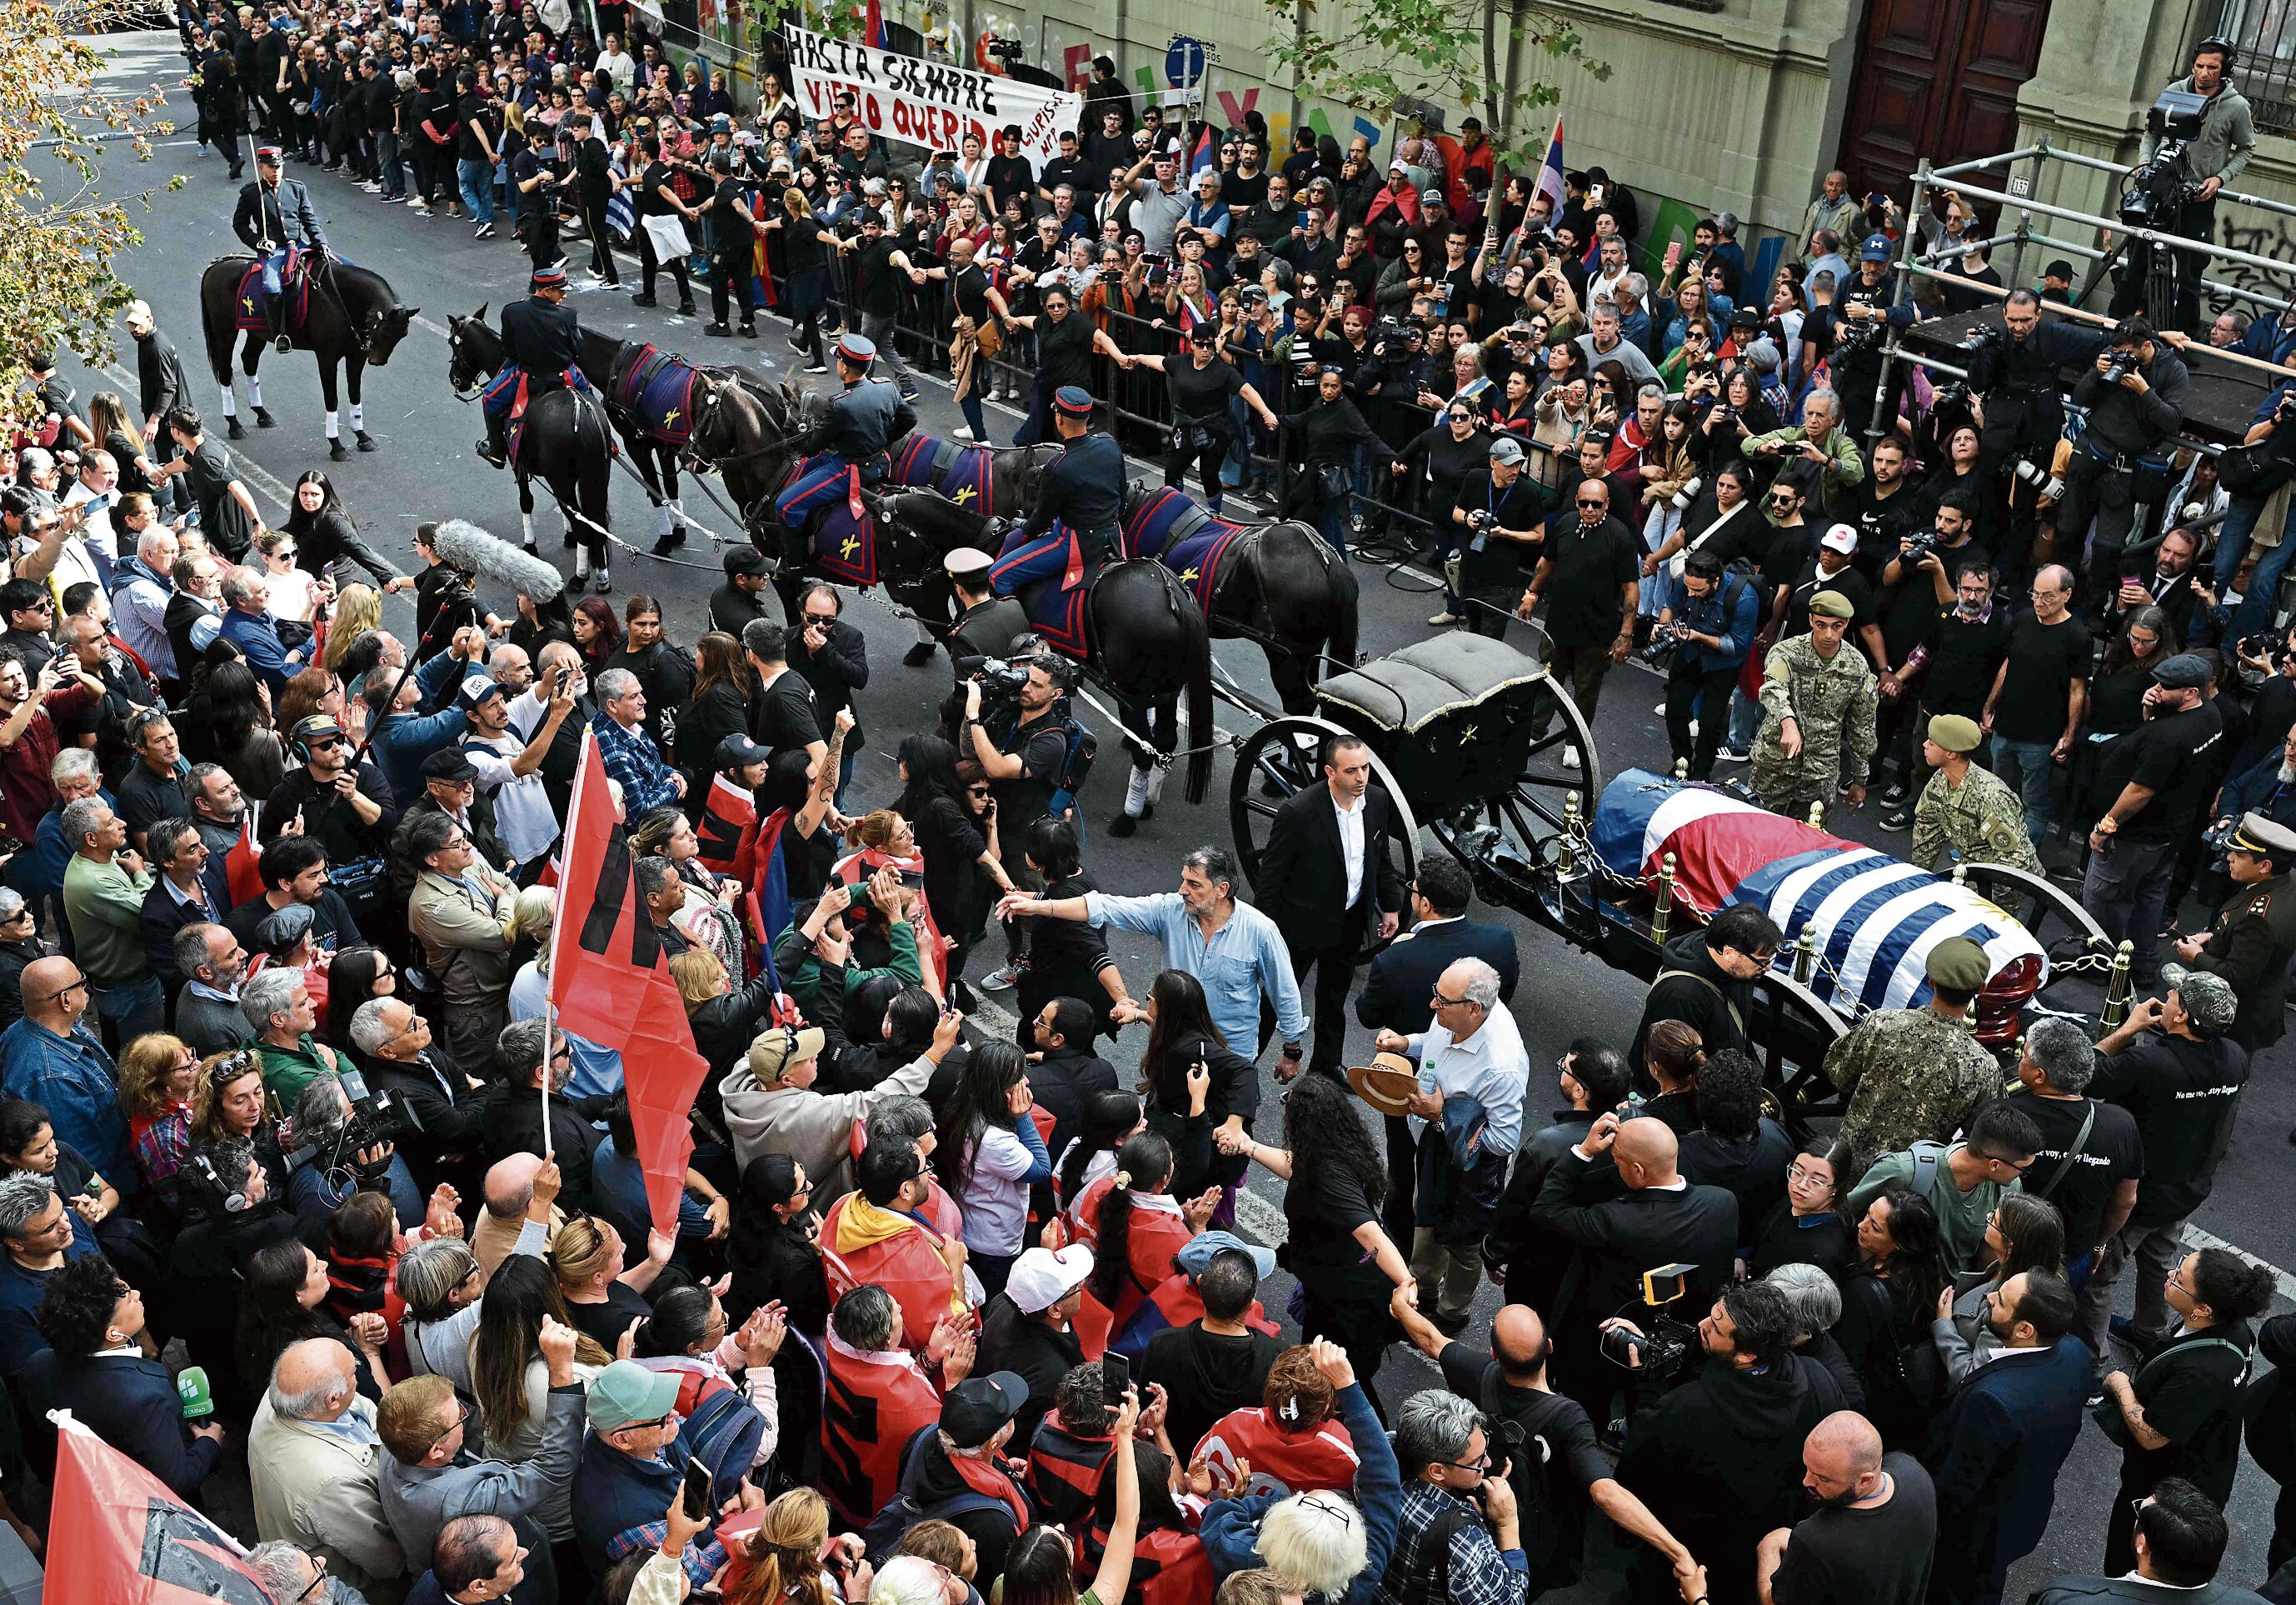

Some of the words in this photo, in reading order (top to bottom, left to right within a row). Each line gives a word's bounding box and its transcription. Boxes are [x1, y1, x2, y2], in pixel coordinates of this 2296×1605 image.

[785, 26, 876, 83] HASTA
[1862, 524, 1881, 535] AIR
[2175, 1091, 2185, 1099] No
[2045, 1150, 2062, 1160] voy,
[2083, 1152, 2111, 1167] llegando
[187, 1407, 206, 1415] CIUDAD
